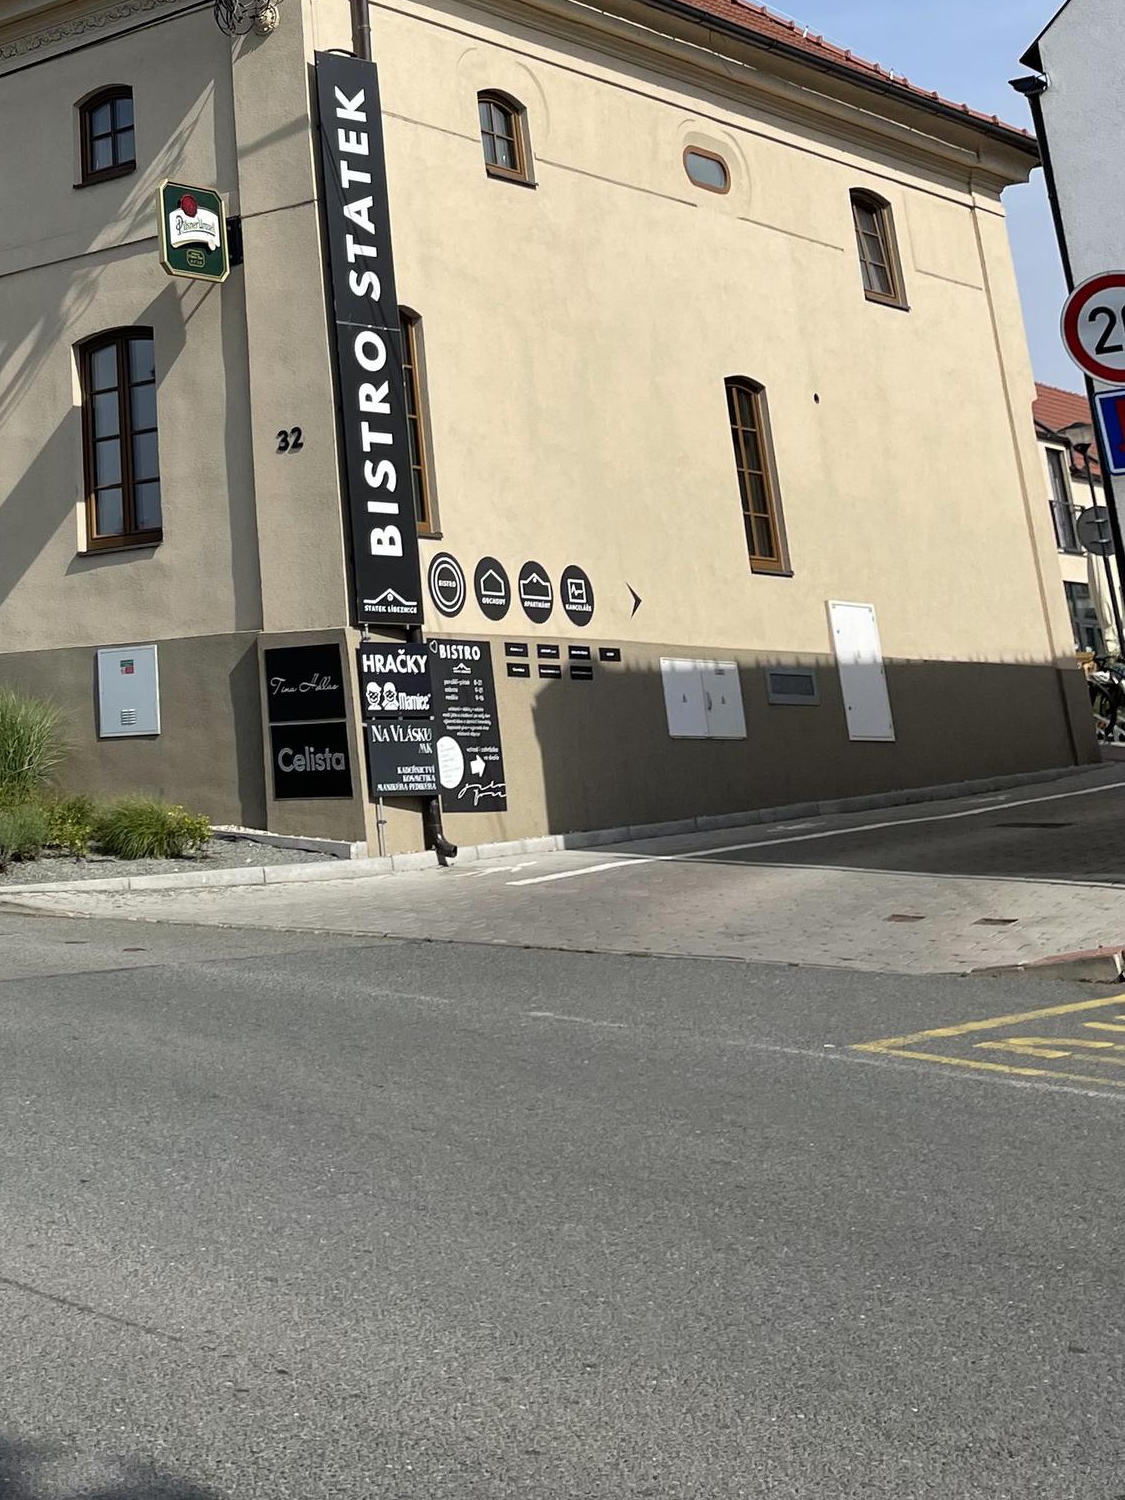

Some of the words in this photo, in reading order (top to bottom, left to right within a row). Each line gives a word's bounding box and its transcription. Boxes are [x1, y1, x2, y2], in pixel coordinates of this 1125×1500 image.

[334, 85, 381, 301] STATEK
[276, 426, 304, 454] 32
[355, 330, 403, 557] BISTRO
[438, 579, 457, 588] BISTRO
[364, 605, 387, 613] STATEK
[362, 649, 428, 674] HRAČKY
[438, 644, 481, 661] BISTRO
[277, 746, 346, 773] Celista
